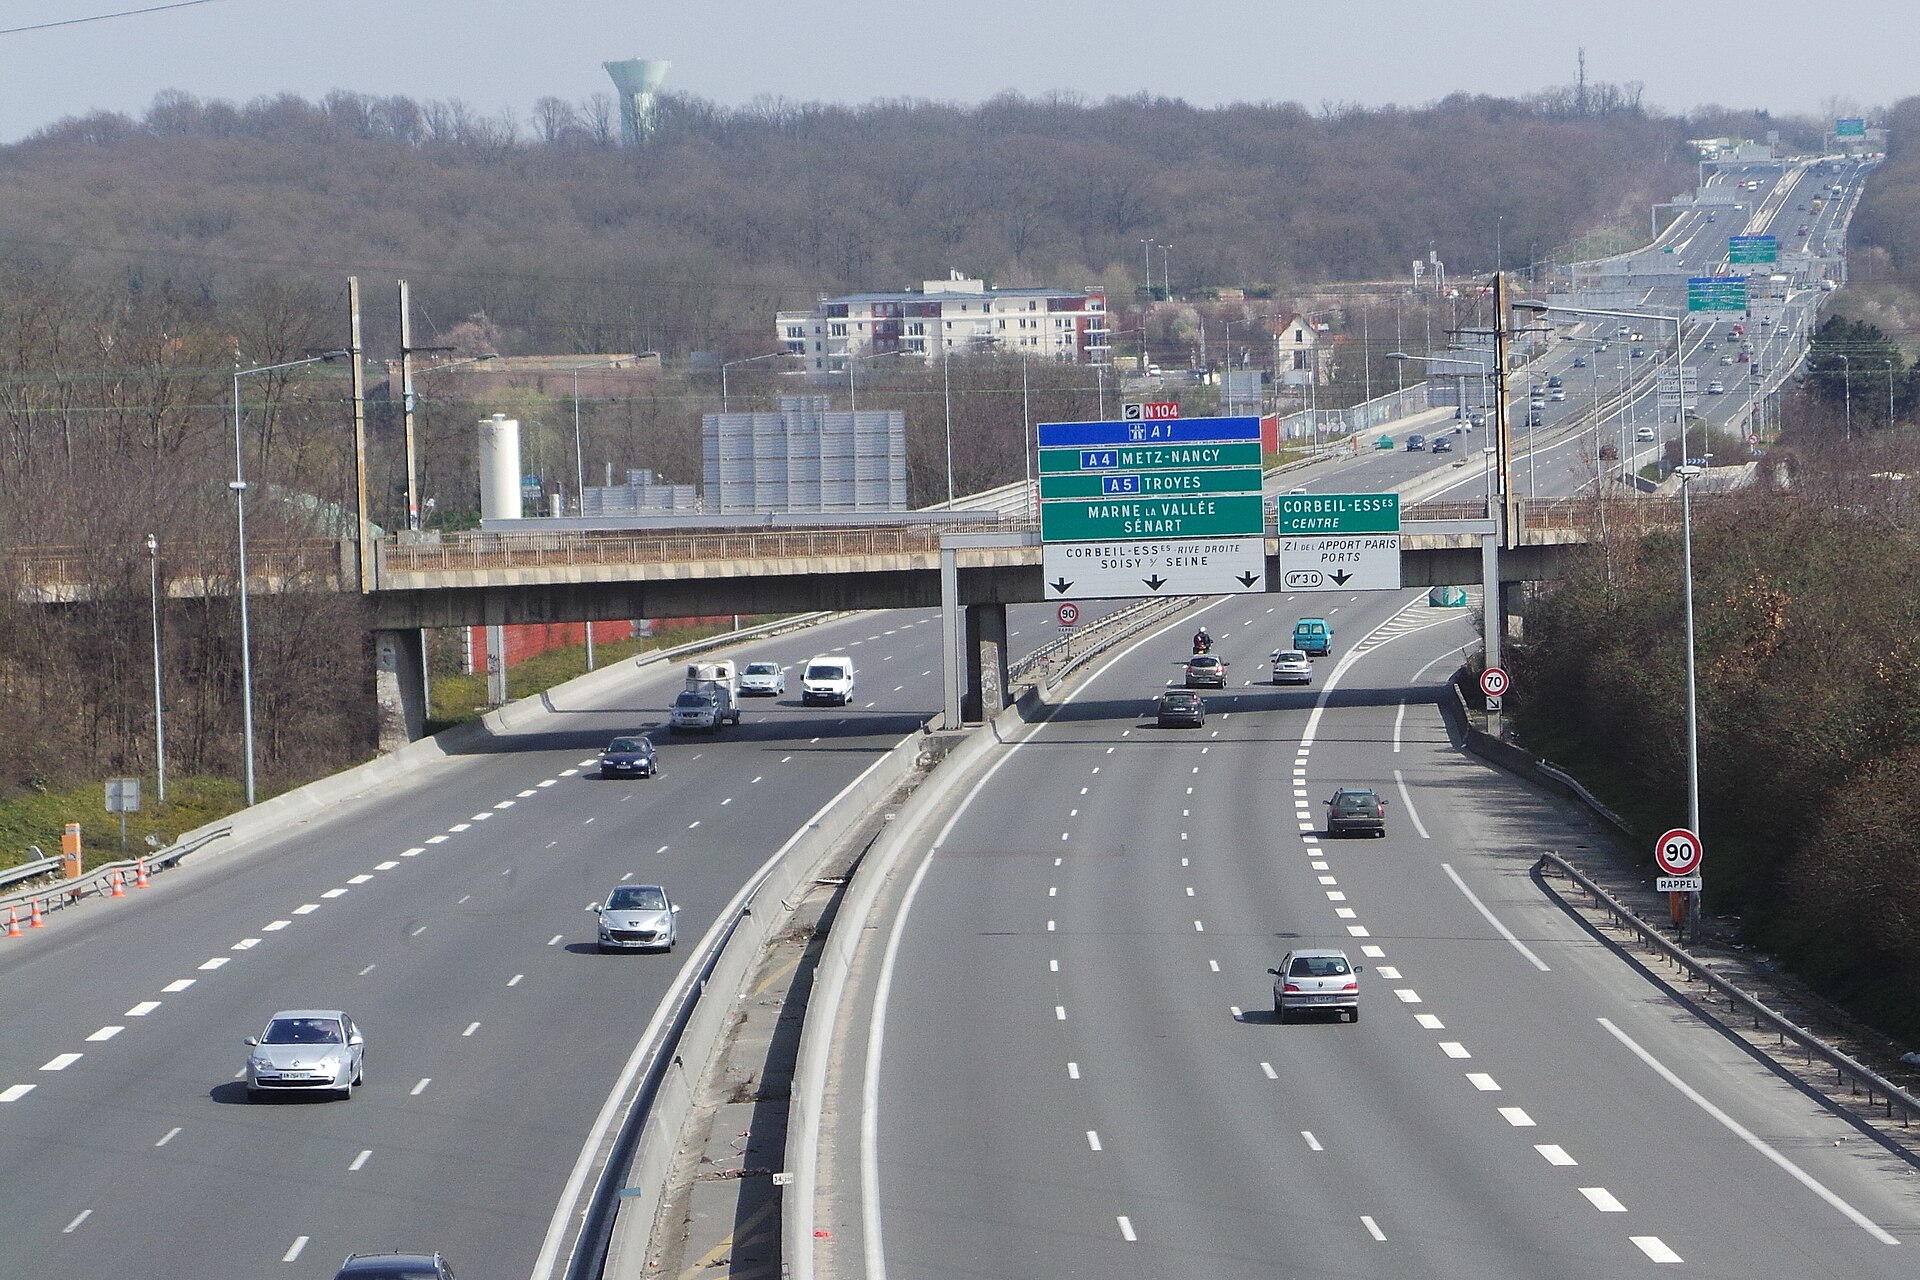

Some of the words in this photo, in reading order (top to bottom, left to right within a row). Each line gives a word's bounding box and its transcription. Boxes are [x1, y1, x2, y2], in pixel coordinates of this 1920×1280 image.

[1145, 404, 1178, 418] N104
[1122, 449, 1220, 465] METZ-NANCY
[1144, 476, 1201, 490] TROYES
[1088, 505, 1140, 519] MARNE
[1145, 507, 1156, 516] LA
[1161, 501, 1216, 516] VALLÉE
[1124, 518, 1182, 533] SÉNART
[1204, 544, 1241, 554] DROITE
[1318, 540, 1362, 550] APPORT
[1364, 539, 1397, 549] PARIS
[1101, 558, 1142, 569] SOISY
[1166, 556, 1208, 567] SEINE
[1321, 552, 1361, 563] PORTS
[1062, 609, 1075, 619] 90
[1487, 676, 1502, 688] 70
[1666, 843, 1692, 862] 90
[1660, 880, 1698, 889] RAPPEL
